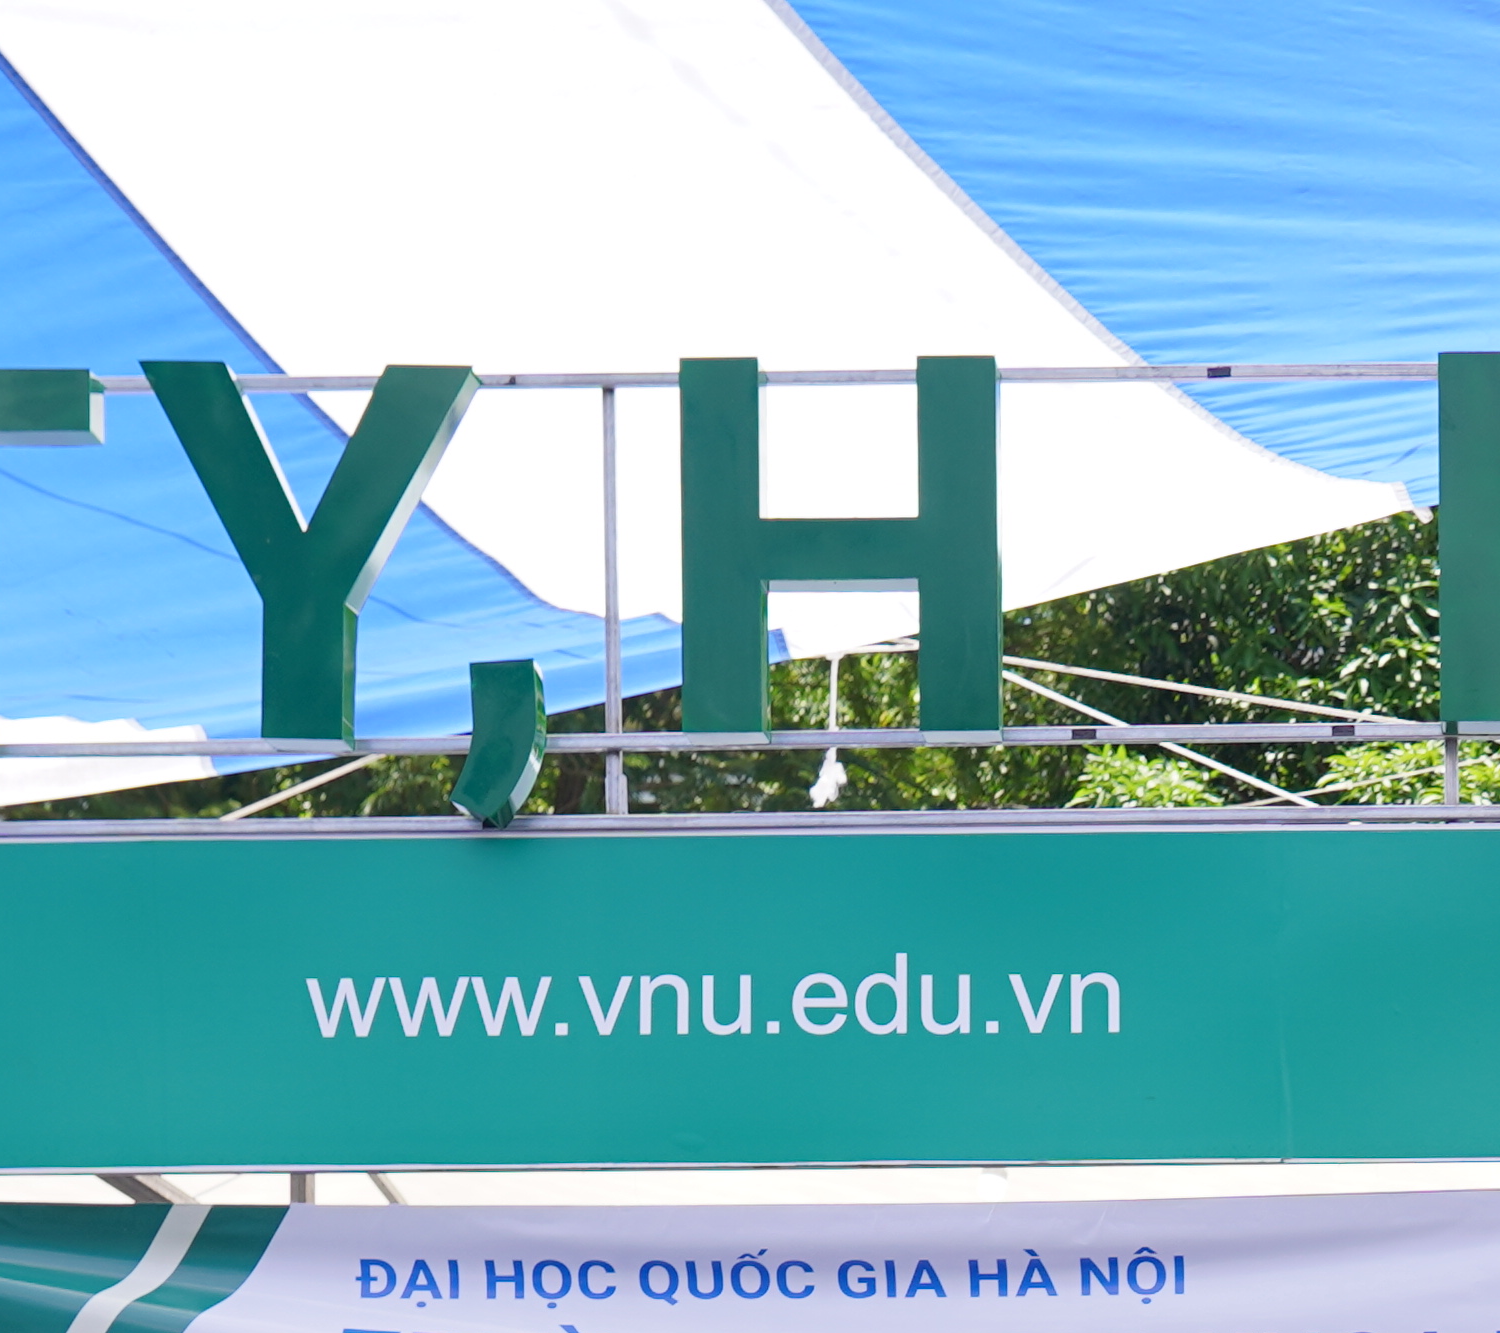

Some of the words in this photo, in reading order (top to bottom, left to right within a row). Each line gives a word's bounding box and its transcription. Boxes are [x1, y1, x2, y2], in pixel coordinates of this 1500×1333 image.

[681, 356, 1000, 740] H
[308, 953, 1122, 1039] www.vnu.edu.vn
[356, 1259, 459, 1307] ĐẠI
[484, 1258, 618, 1309] HỌC
[639, 1249, 815, 1302] QUỐC
[836, 1257, 946, 1300] GIA
[968, 1247, 1059, 1298] HÀ
[1081, 1247, 1185, 1306] NỘI
